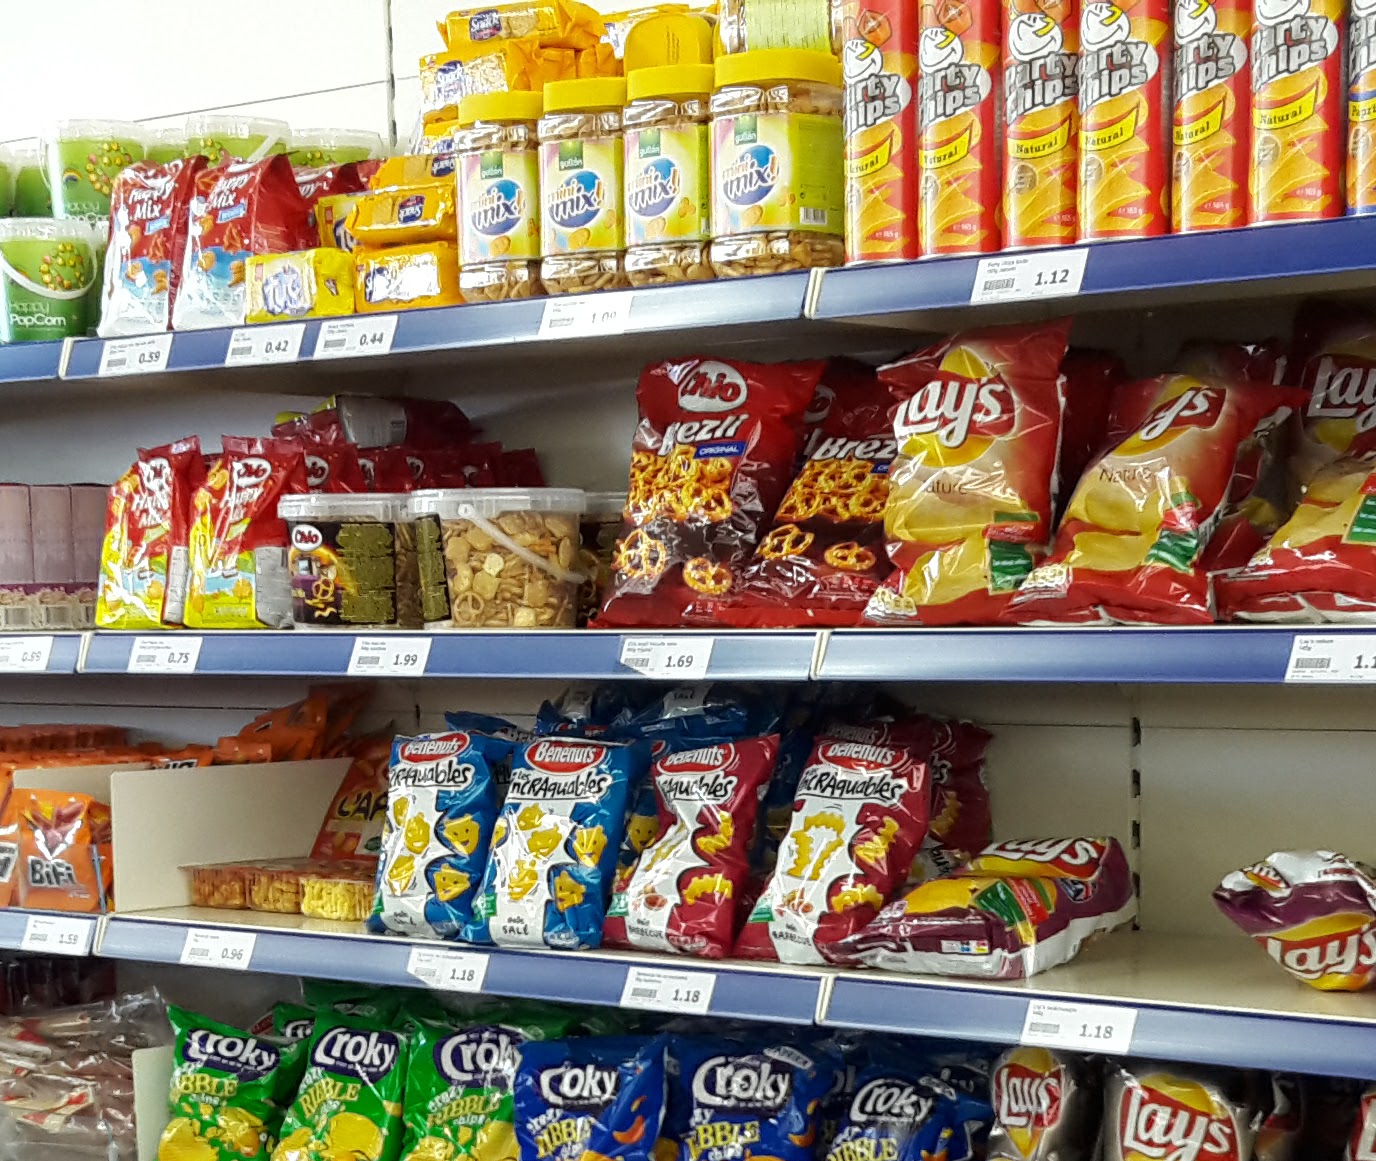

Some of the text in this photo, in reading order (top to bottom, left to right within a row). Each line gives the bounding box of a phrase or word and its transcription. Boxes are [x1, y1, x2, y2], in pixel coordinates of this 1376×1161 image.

[1258, 105, 1304, 126] Natural
[1016, 136, 1058, 155] Natural
[1034, 268, 1071, 288] 1.12
[10, 314, 66, 328] PopCorn
[138, 350, 161, 364] 0.59
[265, 340, 289, 354] 0.42
[893, 376, 1004, 448] Lay's
[167, 651, 191, 665] 0.75
[393, 653, 419, 667] 1.99
[664, 654, 694, 670] 1.69
[535, 742, 597, 765] Benenuts
[30, 858, 79, 885] BiFi
[450, 967, 475, 982] 1.18
[672, 988, 701, 1004] 1.18
[1078, 1022, 1114, 1040] 1.18
[188, 1027, 277, 1069] Croky
[313, 1026, 398, 1072] Croky
[692, 1056, 791, 1106] Croky
[298, 1078, 362, 1118] RIBBLE
[850, 1078, 934, 1122] Croky
[994, 1063, 1062, 1136] Lay's
